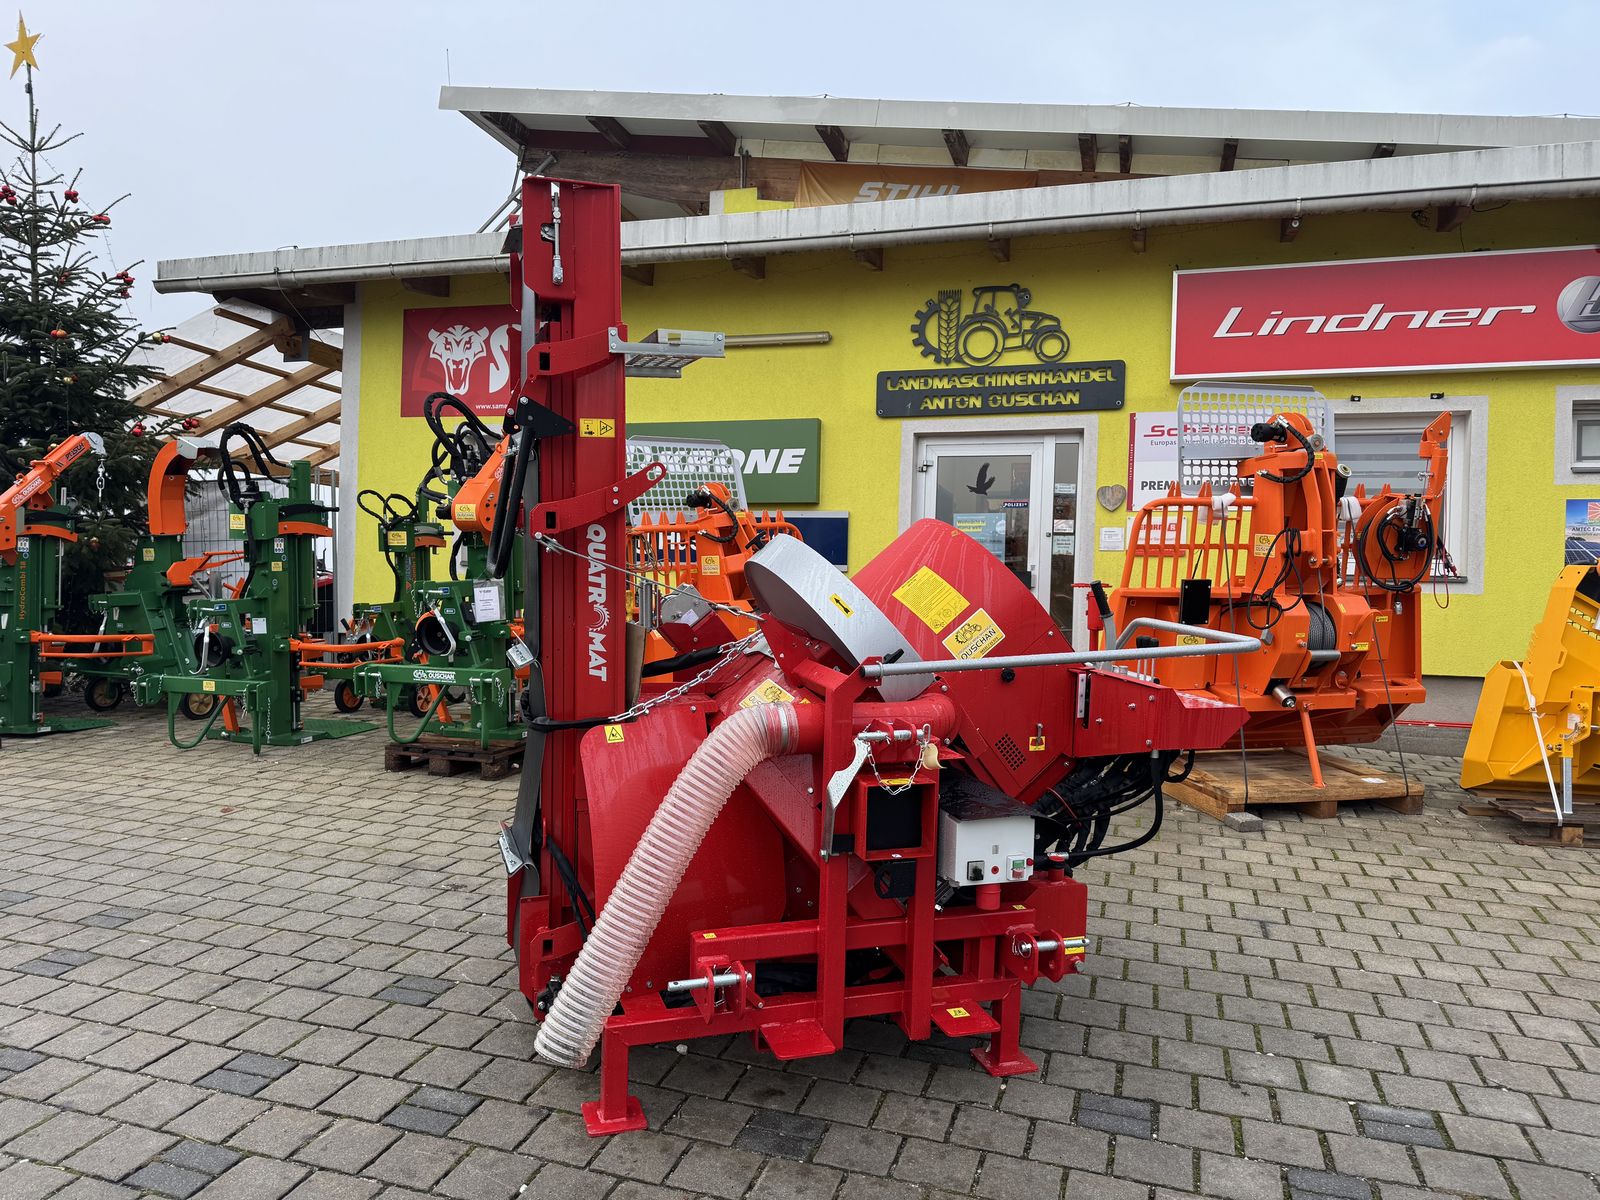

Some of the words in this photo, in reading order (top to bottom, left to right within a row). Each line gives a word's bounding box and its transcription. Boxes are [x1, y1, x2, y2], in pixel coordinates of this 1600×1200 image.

[1213, 303, 1537, 338] Lindner
[886, 367, 1117, 391] LANDMASCHINENHANDEL
[920, 394, 982, 410] ANTON
[988, 391, 1080, 408] OUSCHAN
[1150, 439, 1177, 447] Europas
[961, 628, 996, 660] OUSCHAN
[428, 672, 455, 680] OUSCHAN
